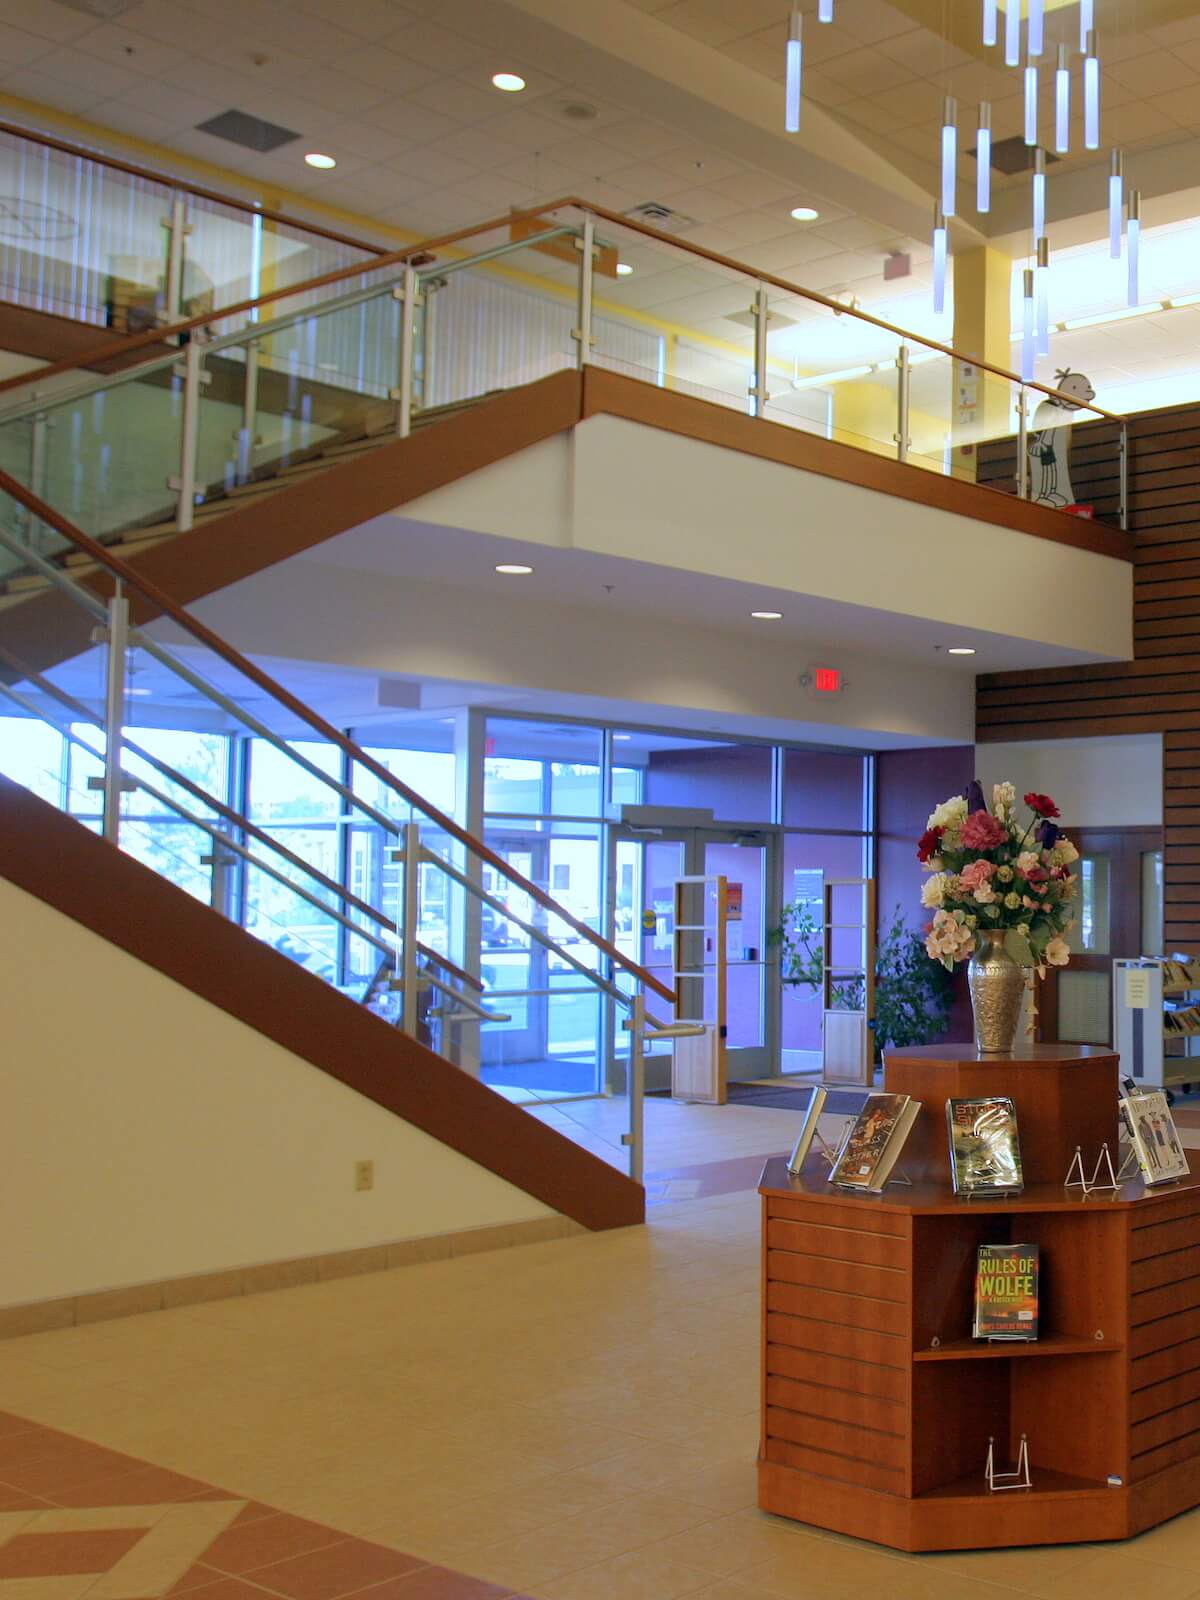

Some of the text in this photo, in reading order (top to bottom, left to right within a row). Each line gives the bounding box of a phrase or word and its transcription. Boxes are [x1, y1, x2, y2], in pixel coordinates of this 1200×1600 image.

[979, 1258, 1035, 1274] RULES OF
[979, 1275, 1034, 1297] WOLFE
